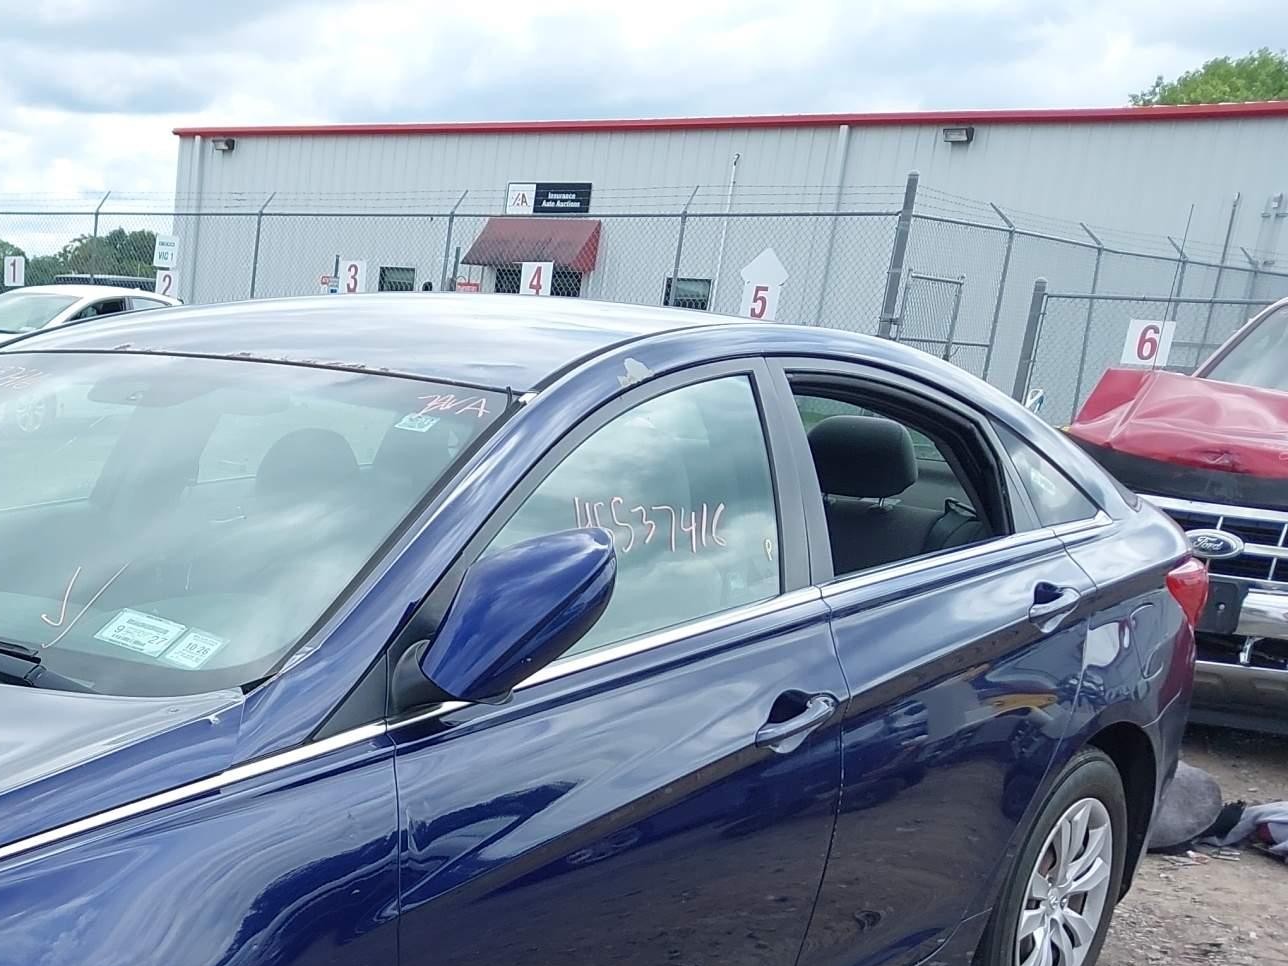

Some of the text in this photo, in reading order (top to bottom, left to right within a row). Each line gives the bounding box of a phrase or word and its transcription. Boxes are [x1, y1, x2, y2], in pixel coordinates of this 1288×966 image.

[541, 199, 581, 208] Auto Auctions
[548, 191, 576, 200] Insurance
[10, 259, 16, 283] 1
[346, 263, 359, 293] 3
[529, 266, 542, 295] 4
[162, 274, 172, 297] 2
[750, 286, 769, 319] 5
[1137, 324, 1160, 361] 6
[1194, 536, 1224, 550] Ford
[147, 635, 168, 646] 27
